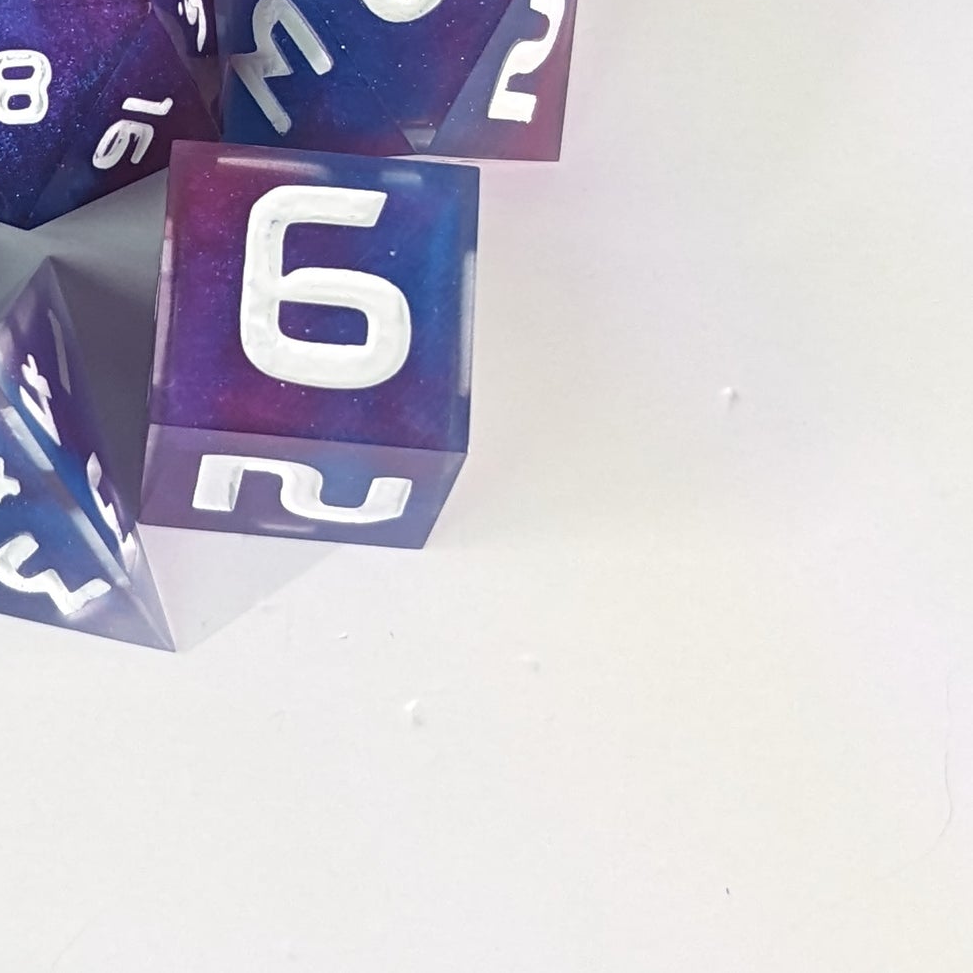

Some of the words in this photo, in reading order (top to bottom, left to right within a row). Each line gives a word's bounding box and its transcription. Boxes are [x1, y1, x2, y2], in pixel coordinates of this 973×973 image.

[92, 97, 174, 170] 16
[240, 184, 412, 390] 6
[191, 454, 413, 525] 2
